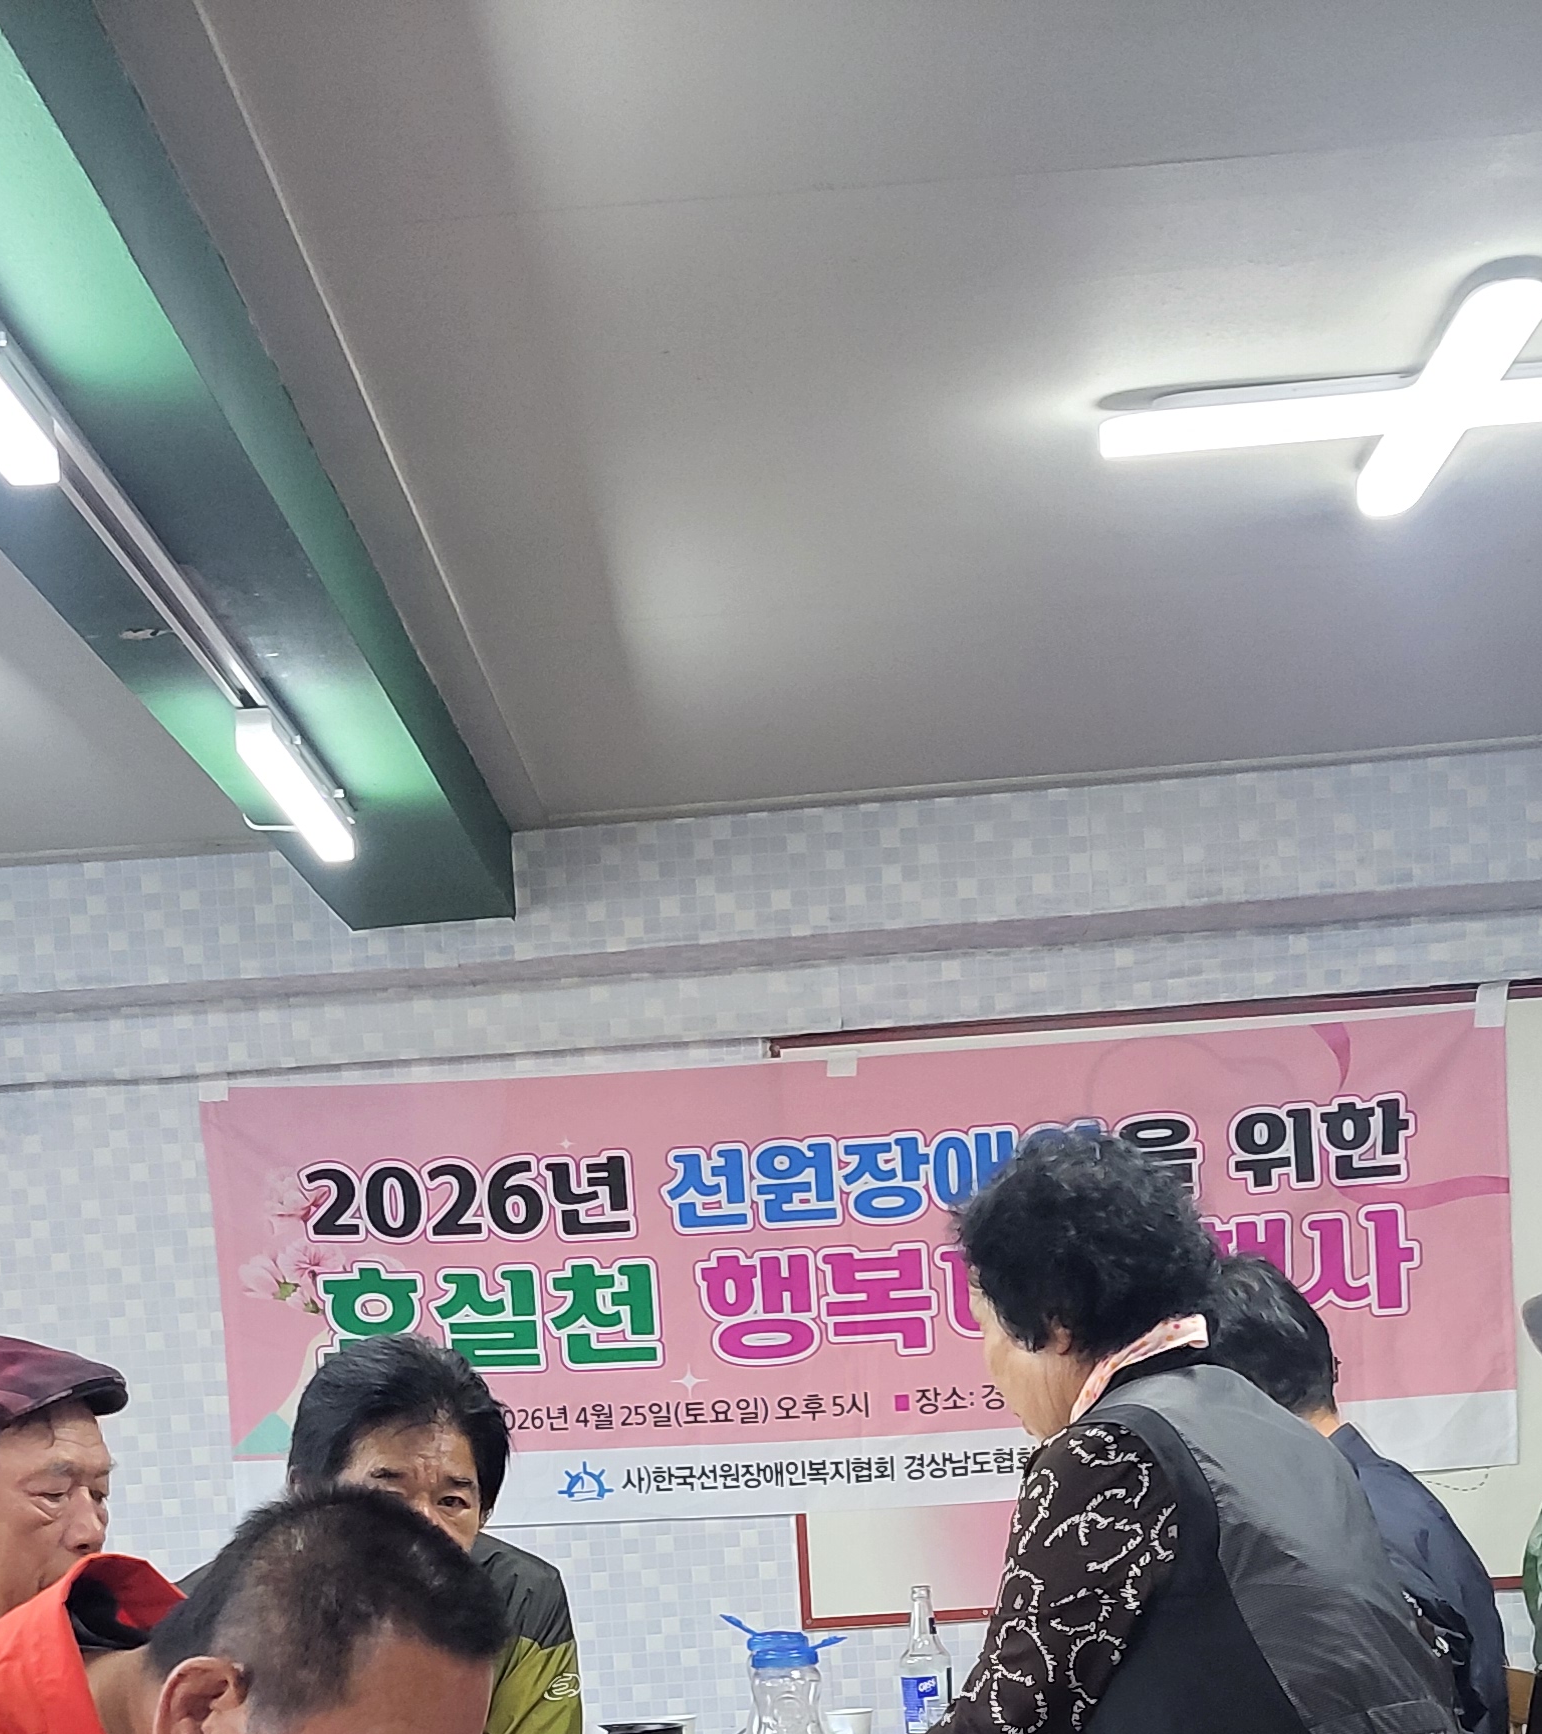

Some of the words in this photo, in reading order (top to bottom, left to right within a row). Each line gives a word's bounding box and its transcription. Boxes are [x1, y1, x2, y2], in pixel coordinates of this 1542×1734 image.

[303, 1153, 633, 1238] 2026년
[665, 1117, 1198, 1229] 선원장애을
[1233, 1097, 1411, 1189] 위한
[502, 1404, 571, 1432] 026년
[575, 1402, 615, 1431] 4월
[620, 1397, 769, 1428] 25일(토요일)
[774, 1394, 828, 1422] 오후
[832, 1391, 871, 1418] 5시
[915, 1386, 975, 1415] 장소:
[621, 1455, 896, 1495] 사)한국선원장애인복지협회
